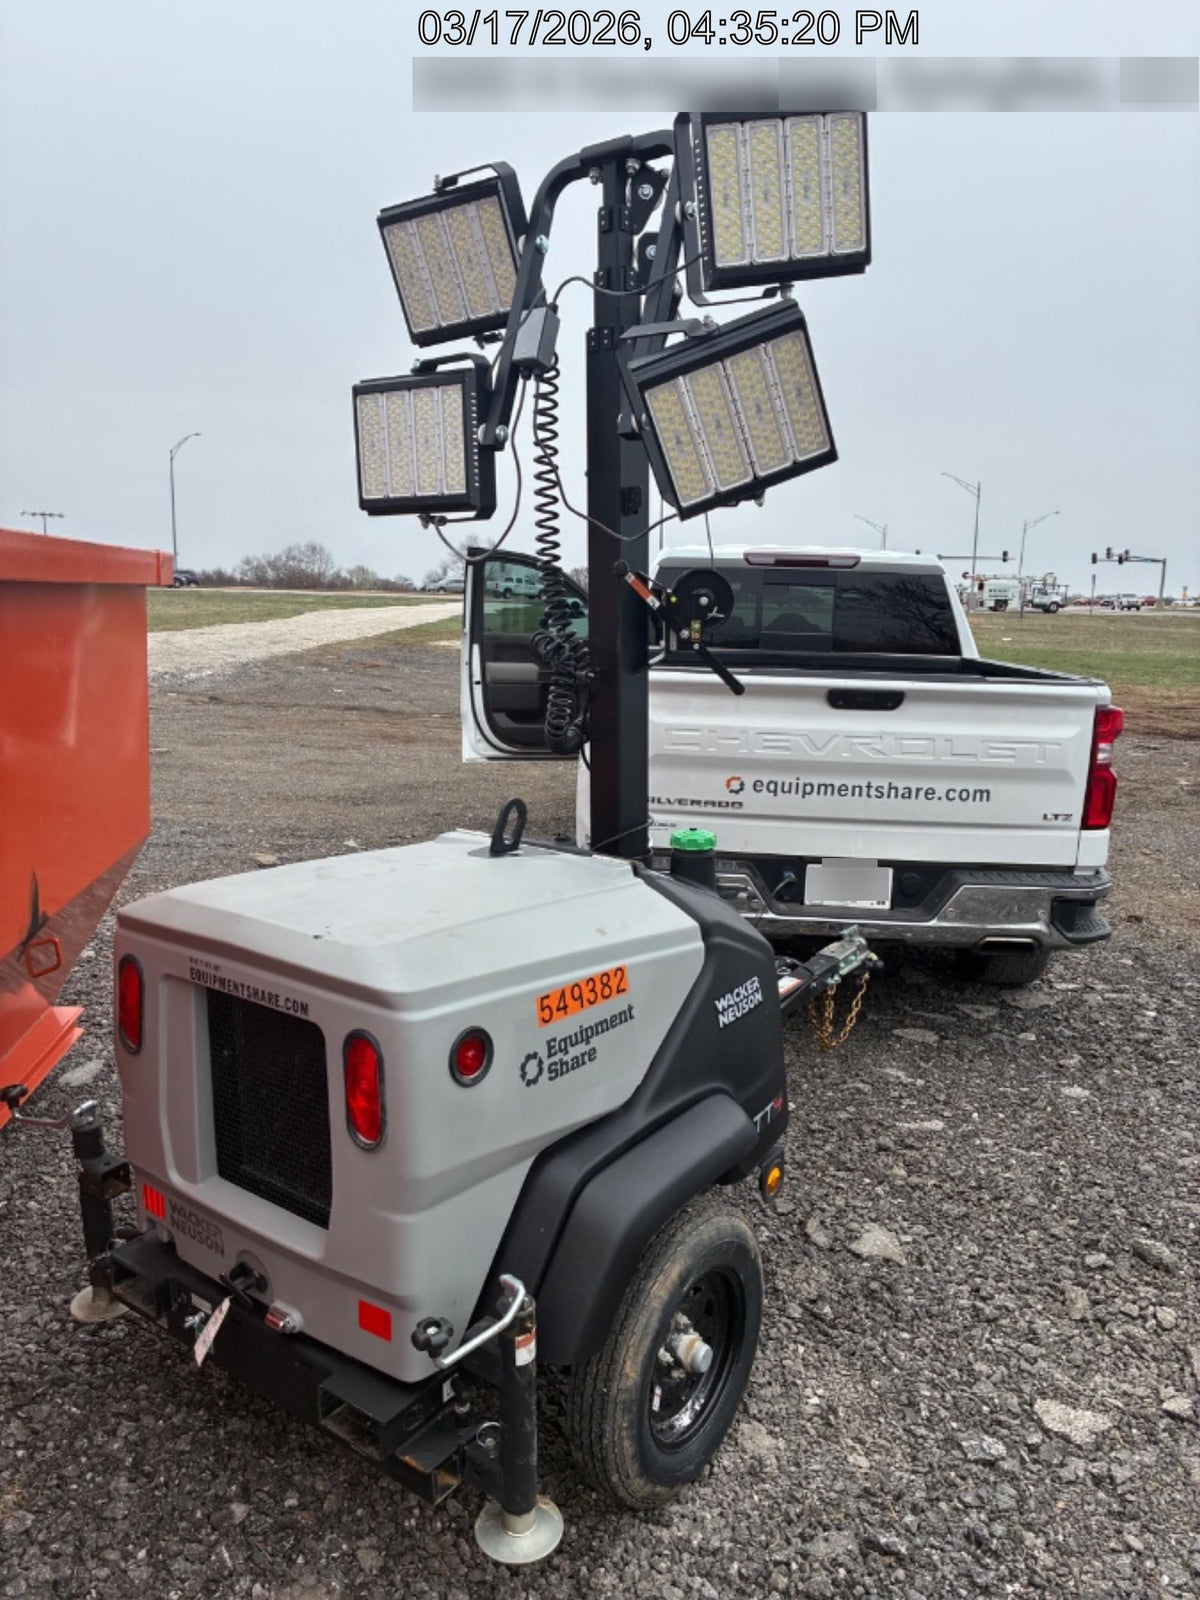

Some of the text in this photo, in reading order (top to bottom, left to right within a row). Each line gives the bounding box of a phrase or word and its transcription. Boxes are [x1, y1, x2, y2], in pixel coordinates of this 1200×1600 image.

[662, 727, 1063, 765] CHEVROLET
[648, 795, 744, 810] ILVERADO
[752, 776, 991, 804] equipmentshare.com
[1042, 812, 1073, 822] LTZ
[189, 966, 309, 1017] EQUIPMENTSHARE.COM
[539, 966, 628, 1025] 549382
[714, 975, 761, 1012] WACKER
[718, 990, 764, 1029] NEUSON
[546, 1003, 635, 1059] Equipment
[546, 1046, 597, 1082] Share
[170, 1214, 225, 1259] NEUSON
